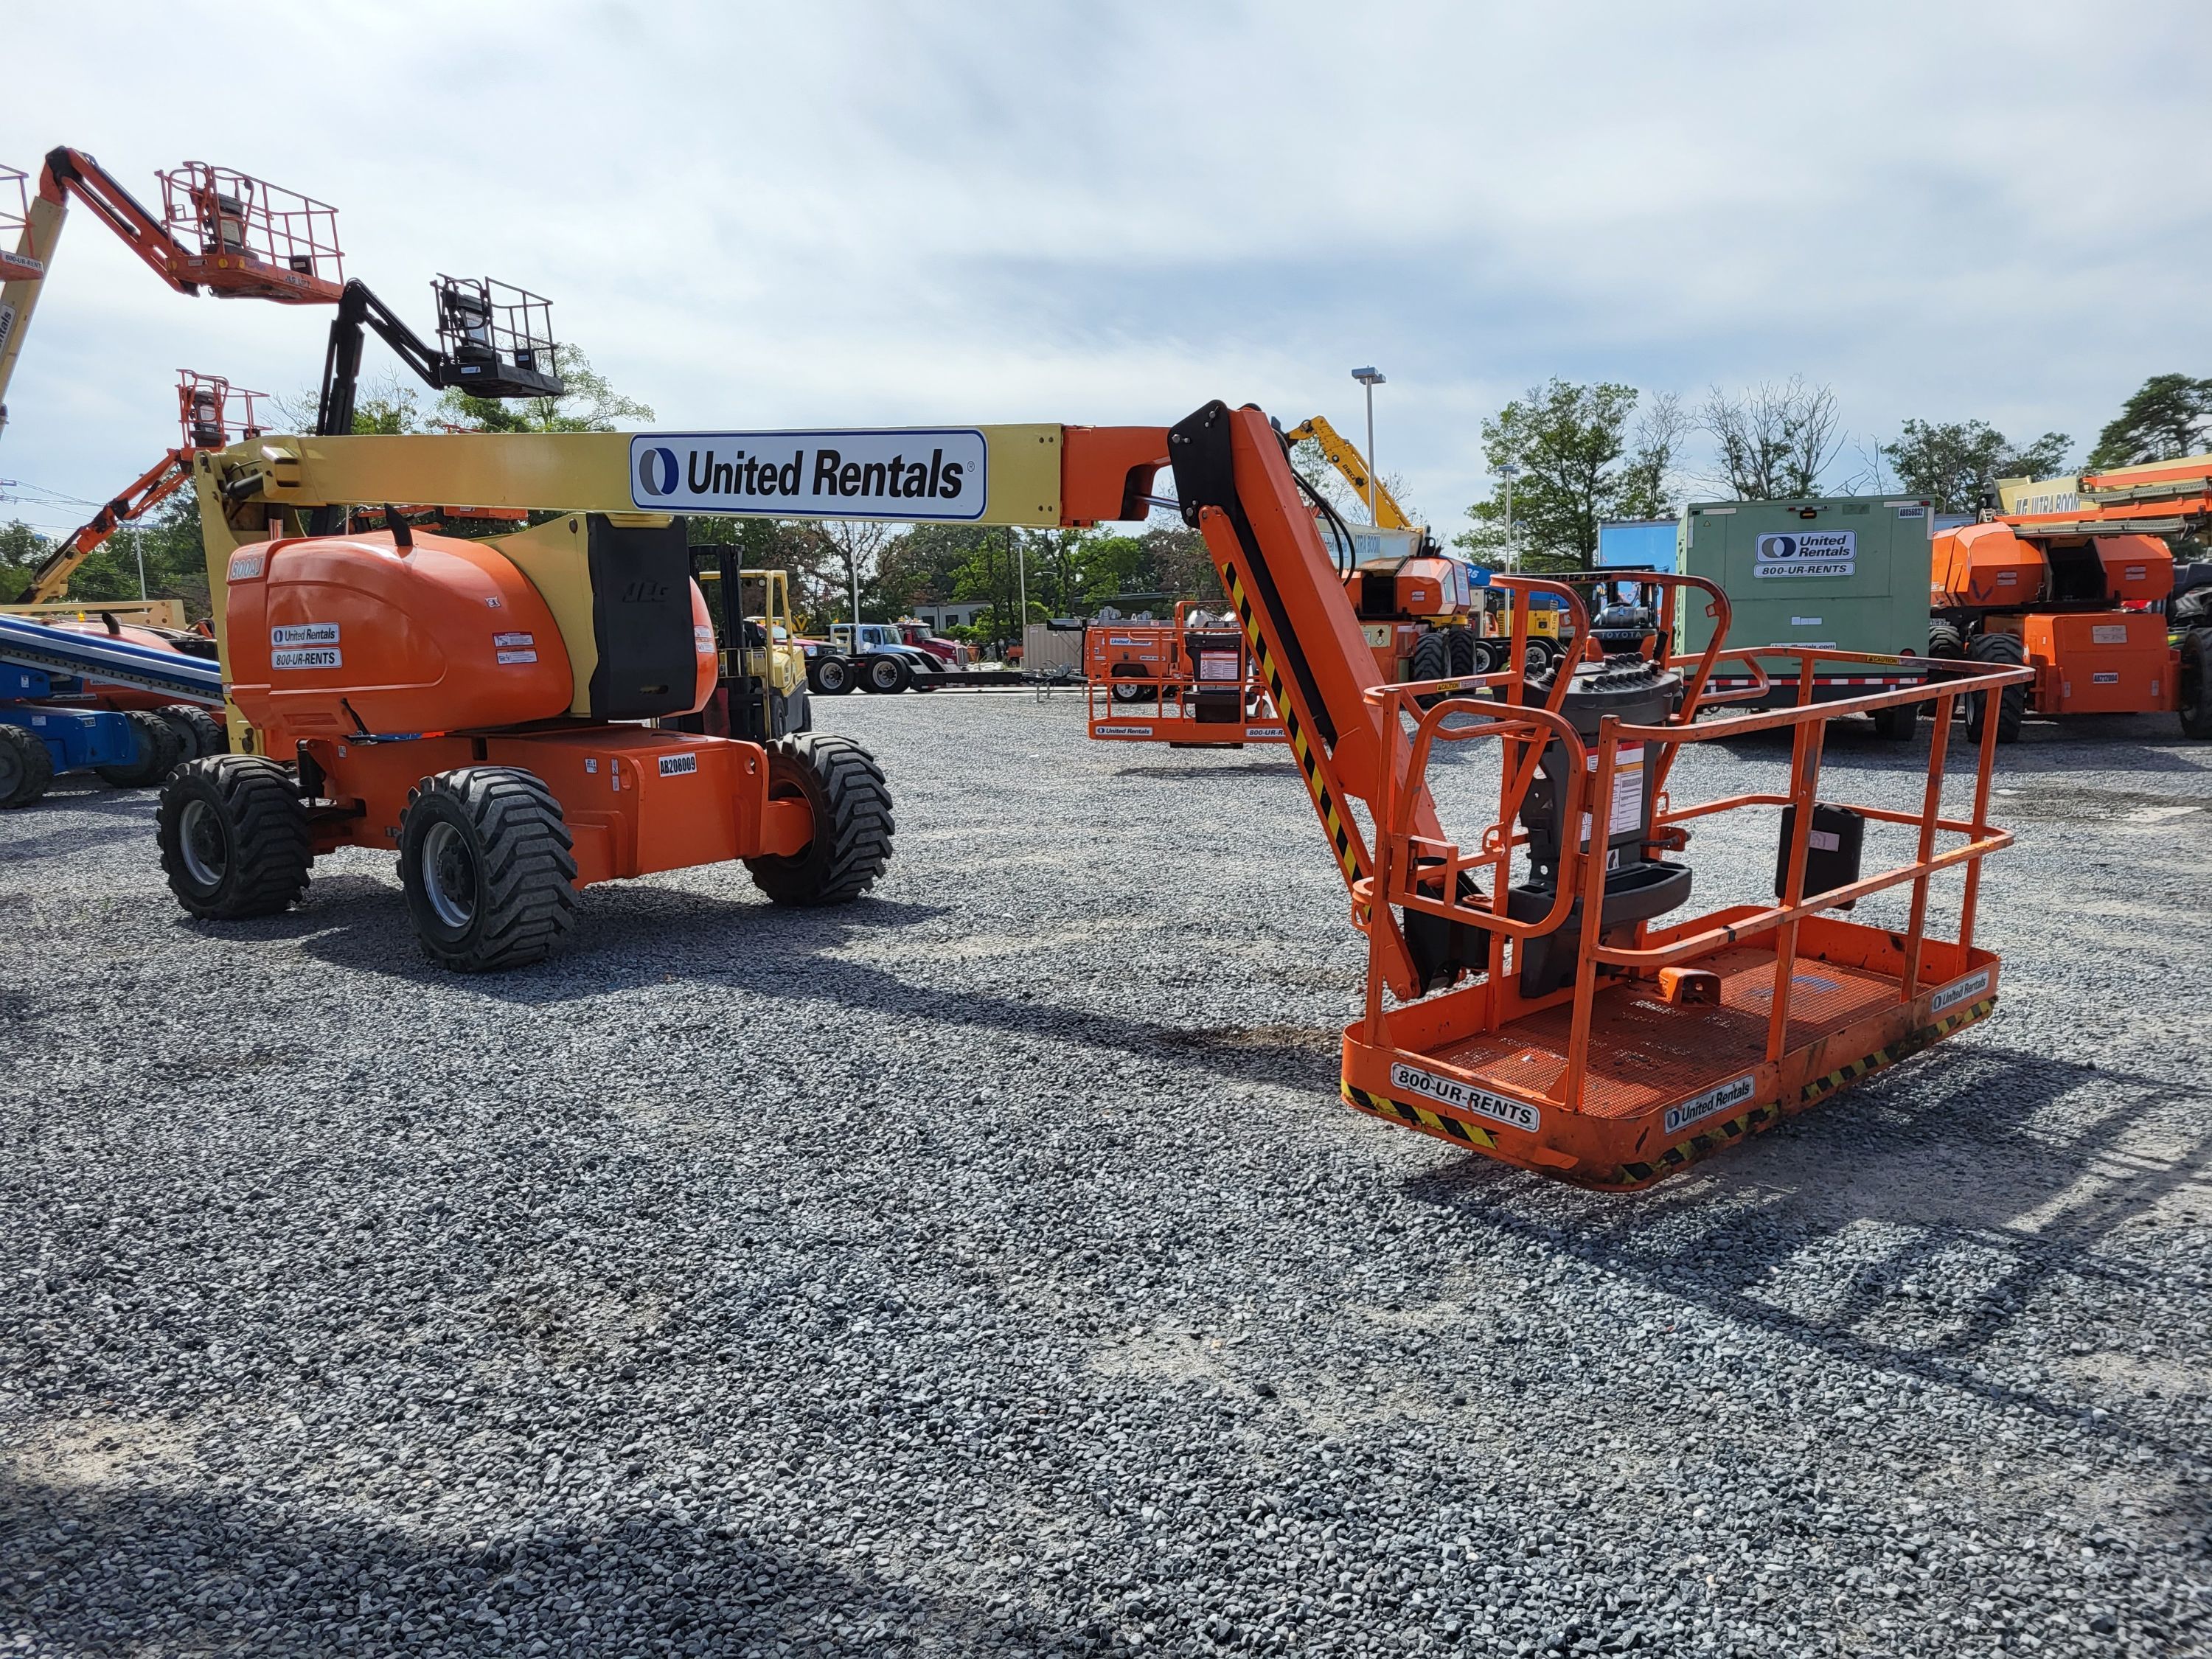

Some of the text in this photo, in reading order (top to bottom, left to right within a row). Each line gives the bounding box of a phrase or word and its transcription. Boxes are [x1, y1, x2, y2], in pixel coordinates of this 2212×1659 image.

[0, 310, 12, 347] ntals
[687, 448, 964, 498] United Rentals
[1799, 535, 1847, 546] United
[1798, 546, 1851, 557] Rentals
[232, 557, 264, 579] 800AJ
[1761, 565, 1847, 575] 800-UR-RENTS
[285, 628, 335, 641] United Rentals
[276, 652, 335, 666] 800-UR-RENTS
[1441, 681, 1458, 690] CAUTION
[660, 757, 696, 775] AB208009
[1942, 976, 1986, 1005] United Rentals
[1398, 1070, 1532, 1124] 800-UR-RENTS
[1682, 1082, 1750, 1122] United Rentals
